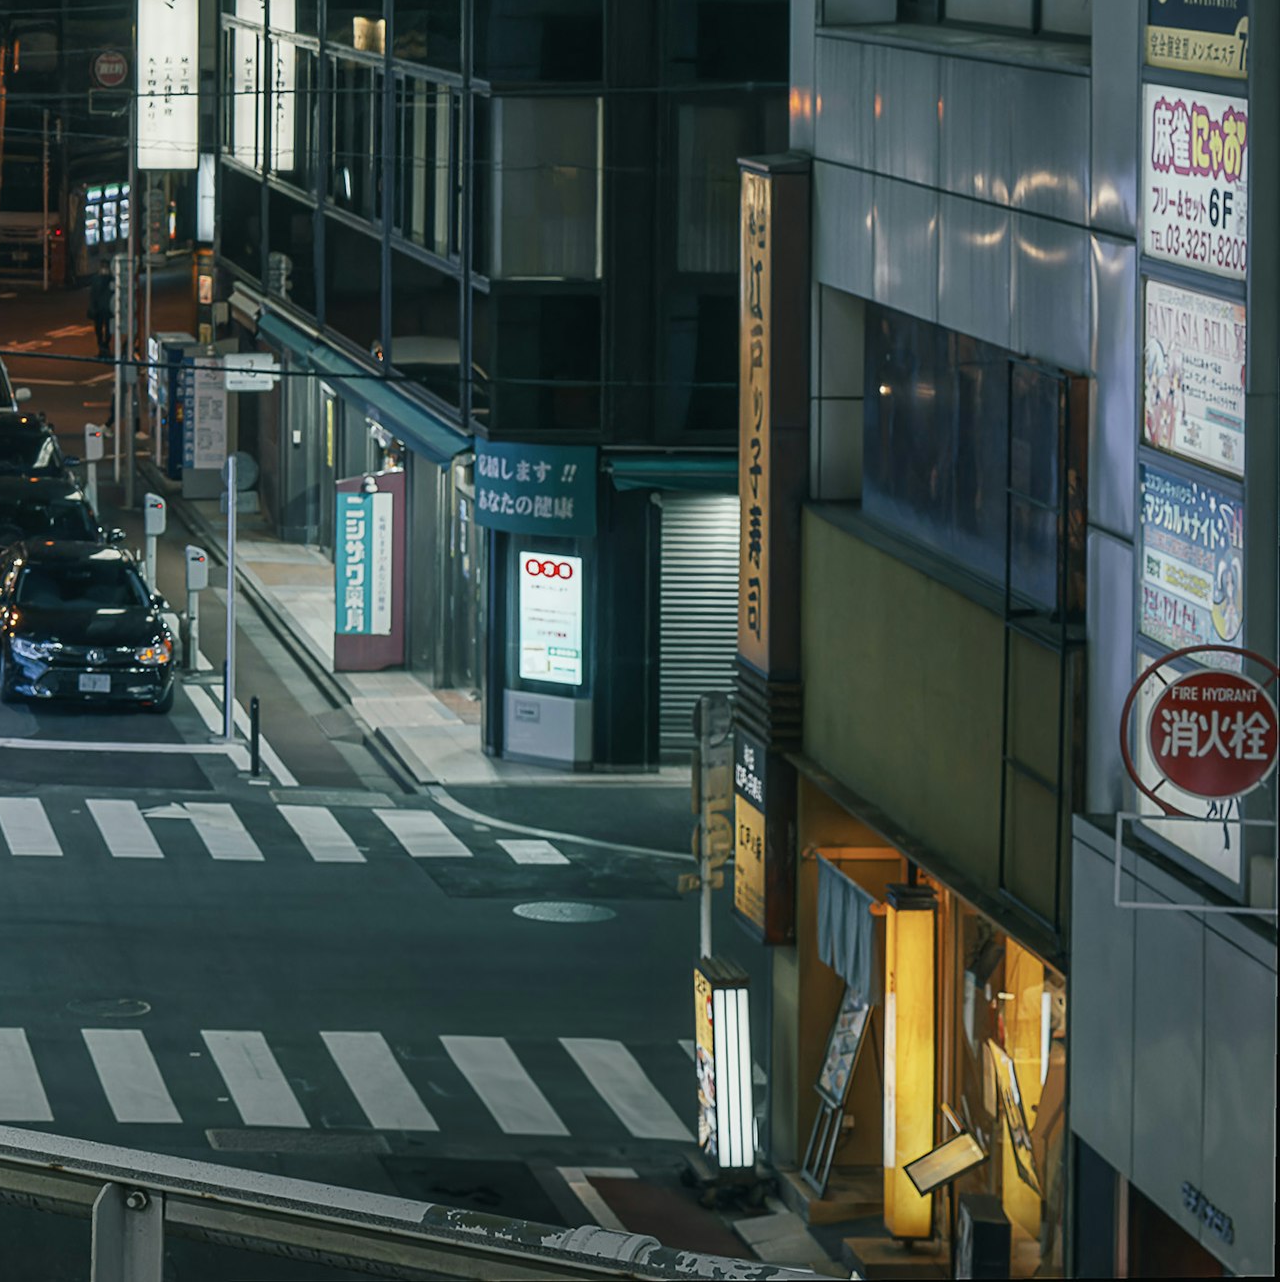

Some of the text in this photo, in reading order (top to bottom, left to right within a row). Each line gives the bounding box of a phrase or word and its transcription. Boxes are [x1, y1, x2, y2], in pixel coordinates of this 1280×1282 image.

[1209, 188, 1233, 229] 6F
[1172, 685, 1257, 702] FIRE HYDRANT
[1161, 708, 1270, 760] 消火栓
